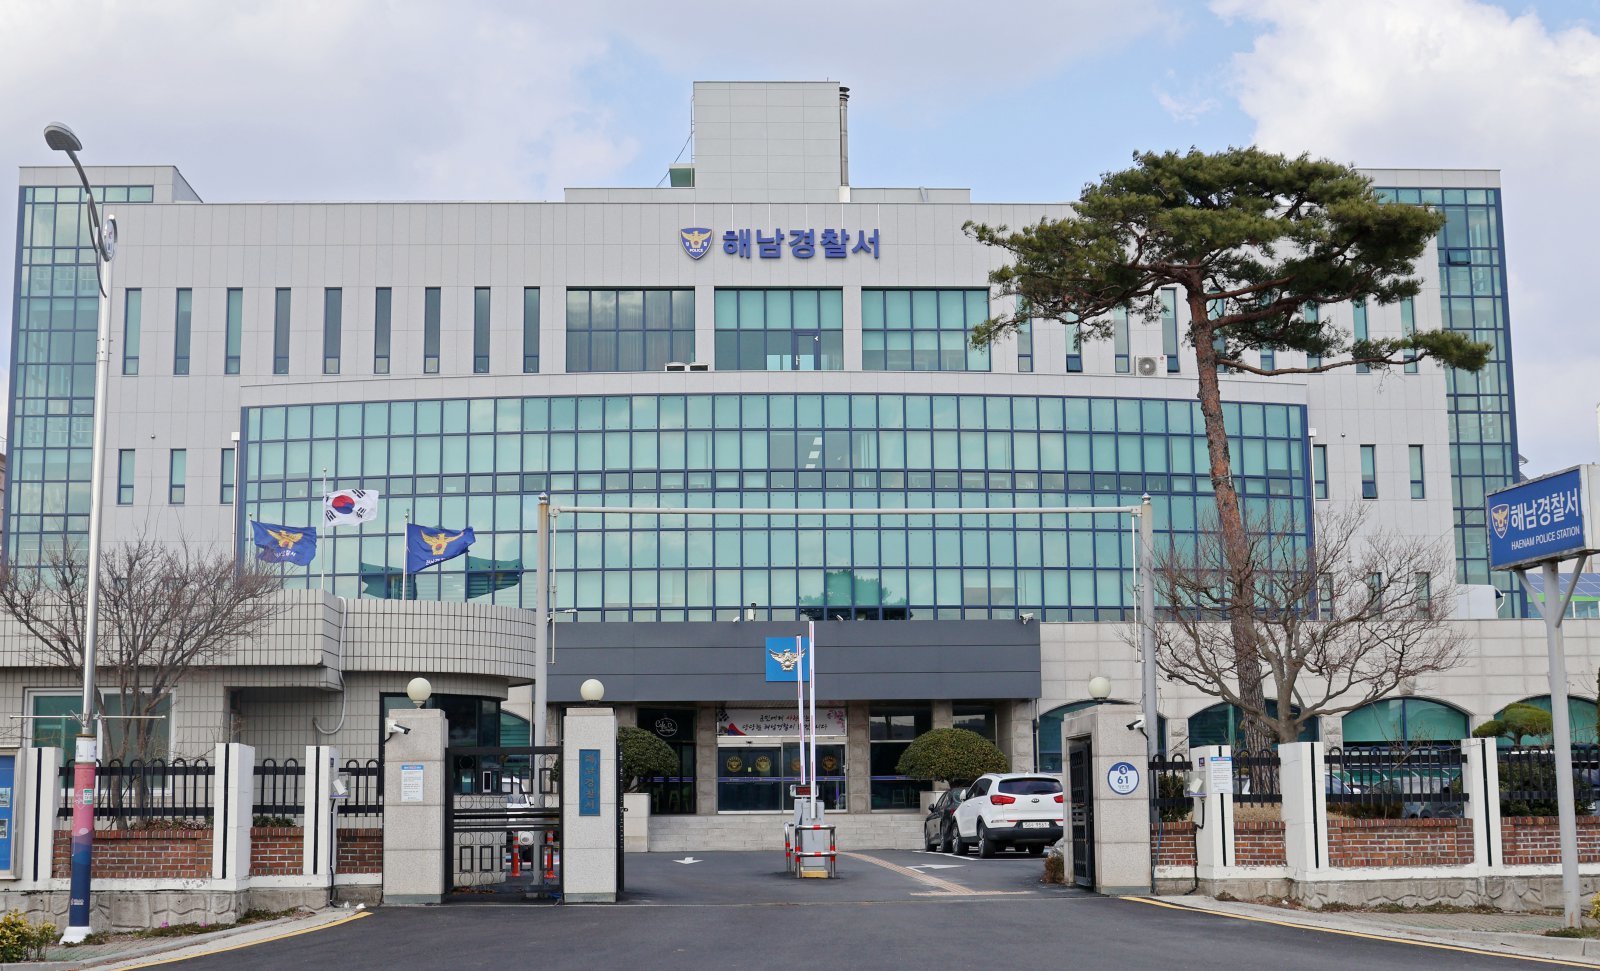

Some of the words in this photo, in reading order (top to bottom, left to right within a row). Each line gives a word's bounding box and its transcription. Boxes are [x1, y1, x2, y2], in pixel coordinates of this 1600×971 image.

[722, 228, 880, 260] 해남경찰서
[1510, 488, 1579, 531] 해남경찰서
[1511, 537, 1535, 550] HAENAM
[1535, 531, 1556, 544] POLICE
[1556, 525, 1581, 540] STATION
[1117, 775, 1129, 785] 61
